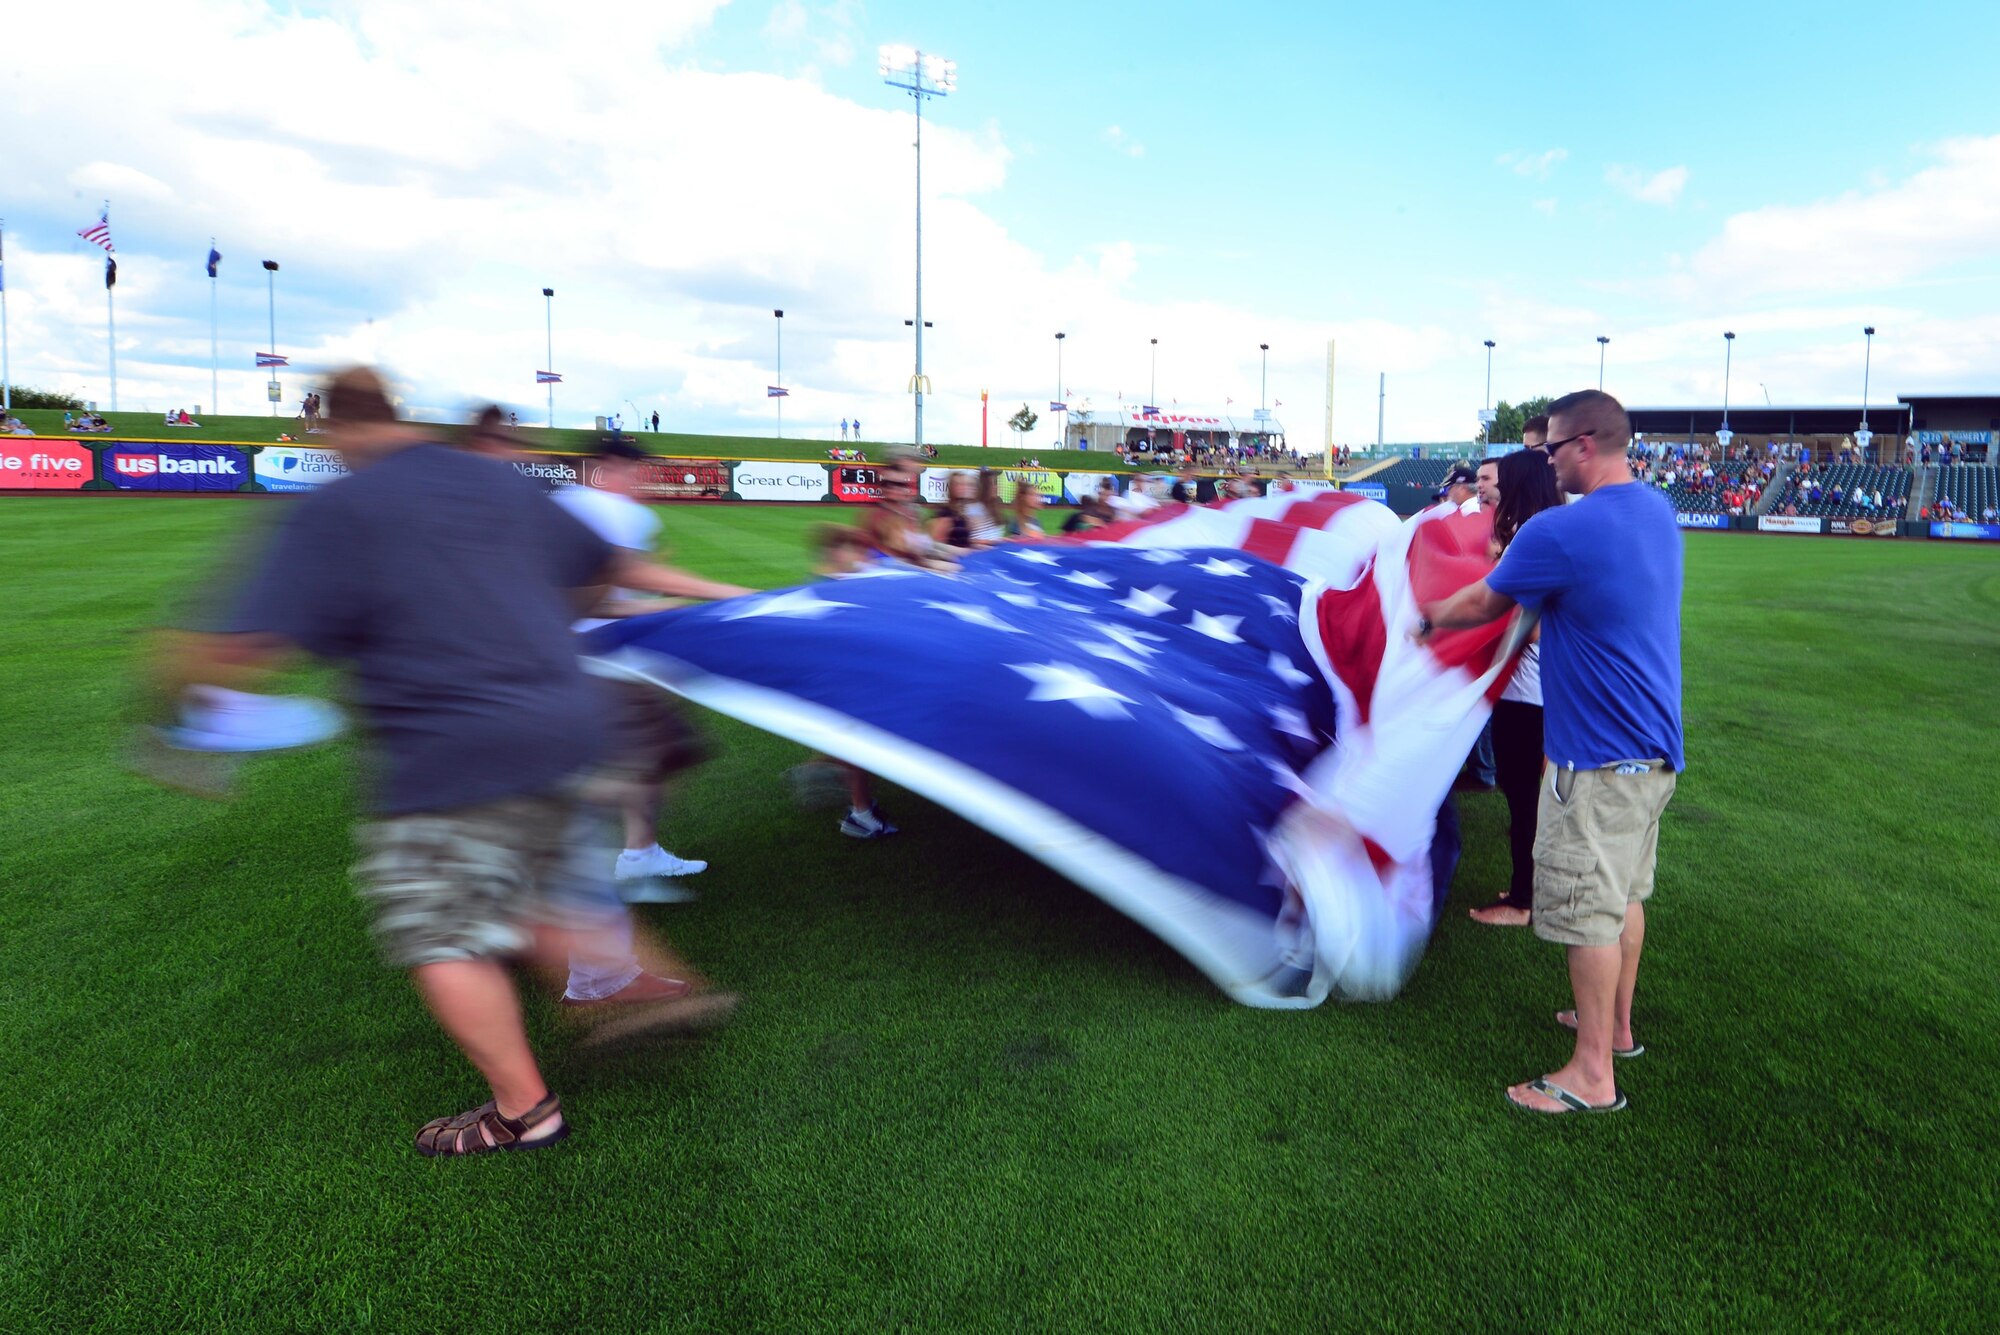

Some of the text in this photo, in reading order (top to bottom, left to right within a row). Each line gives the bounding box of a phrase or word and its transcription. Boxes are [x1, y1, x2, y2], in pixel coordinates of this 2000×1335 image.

[30, 453, 82, 471] five
[512, 463, 577, 479] Nebraska
[856, 469, 875, 484] 67
[738, 474, 823, 489] Great Clips
[1676, 513, 1719, 526] GILDAN
